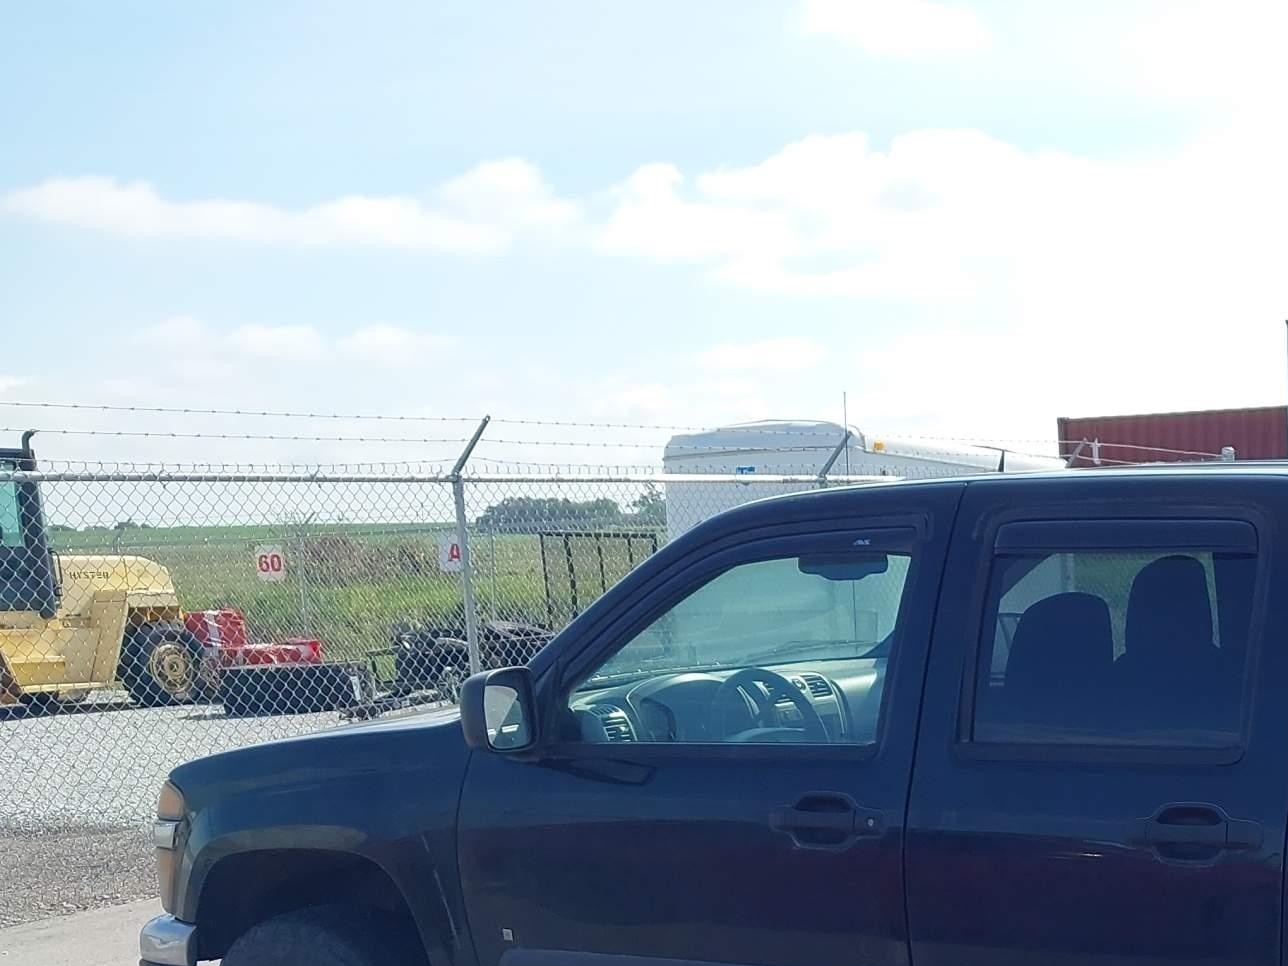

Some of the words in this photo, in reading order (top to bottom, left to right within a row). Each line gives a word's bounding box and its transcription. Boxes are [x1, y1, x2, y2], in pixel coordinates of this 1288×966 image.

[448, 543, 461, 561] A
[258, 553, 282, 573] 60
[69, 571, 109, 580] HYSTER
